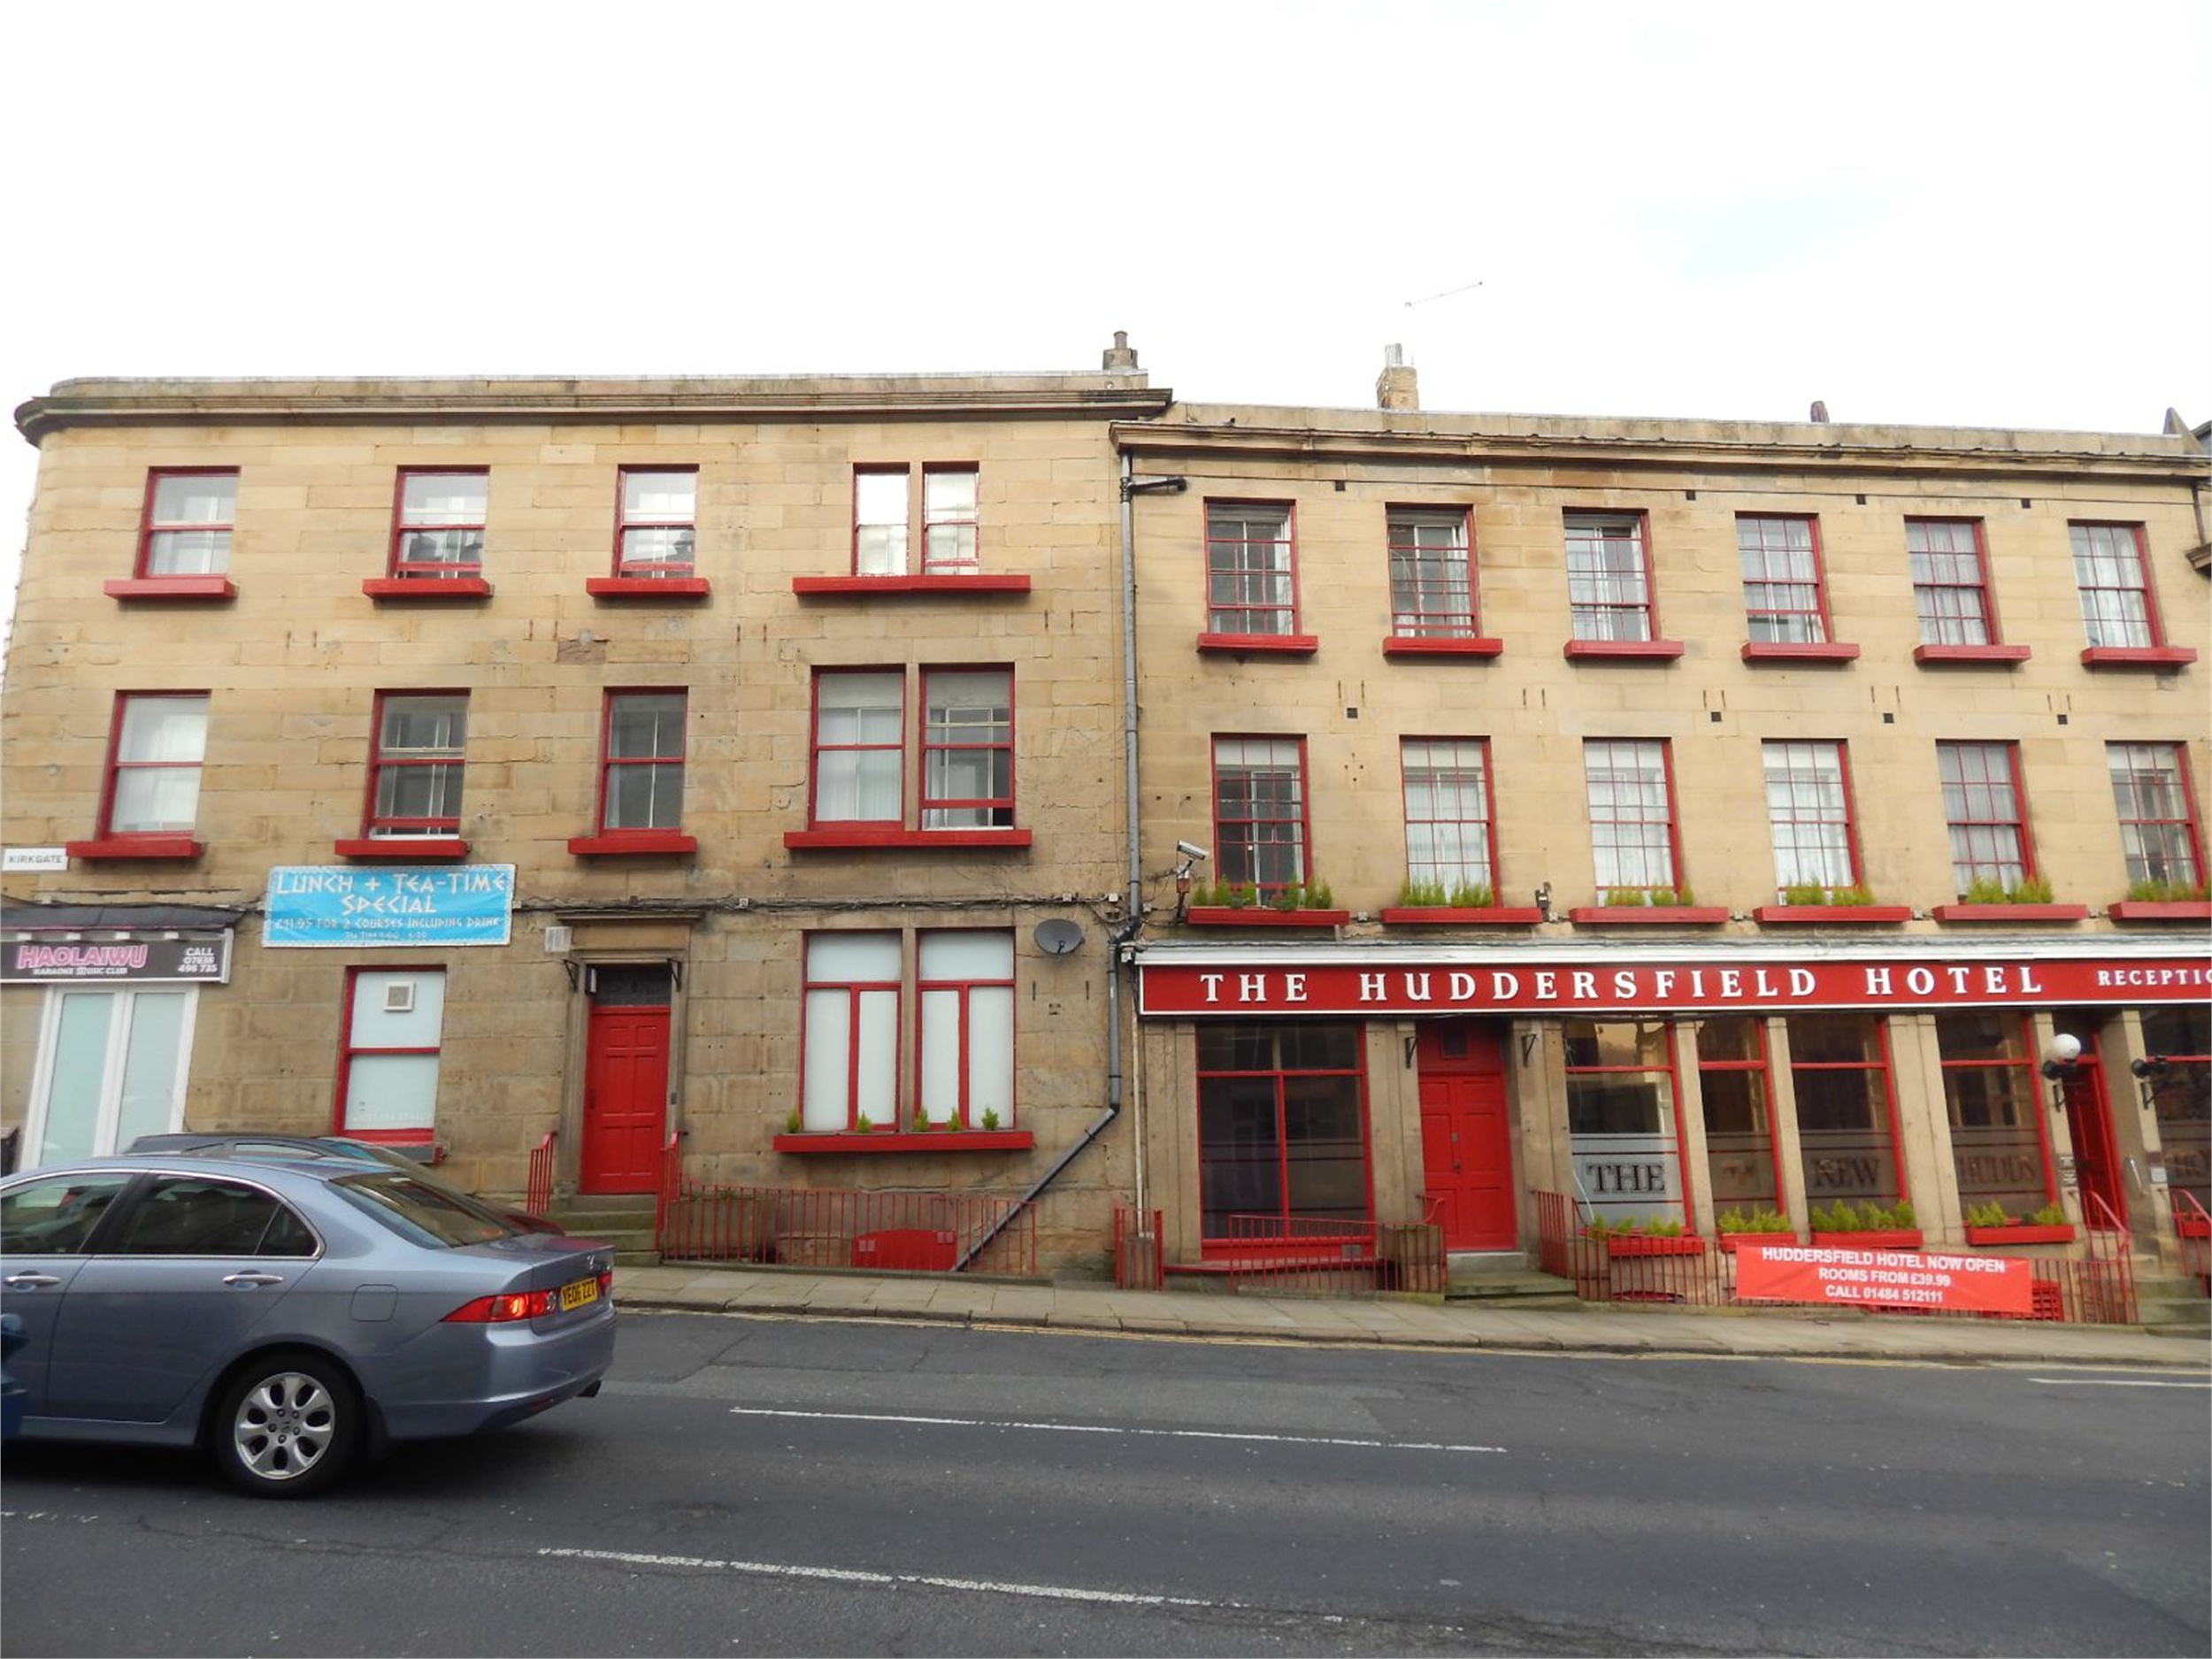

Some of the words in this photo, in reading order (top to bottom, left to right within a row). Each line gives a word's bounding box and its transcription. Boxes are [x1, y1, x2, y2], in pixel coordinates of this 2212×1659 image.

[8, 854, 63, 864] KIRKGATE
[276, 872, 353, 895] LUNCH
[392, 872, 506, 895] TEA-TIME
[342, 895, 437, 916] SPECIAL
[355, 917, 403, 930] COURSES
[408, 916, 463, 928] INCLUDING
[466, 916, 501, 928] DRINK
[16, 944, 149, 969] HAOLAIWU
[186, 947, 214, 956] CALL
[1200, 972, 1310, 1003] THE
[1358, 968, 1816, 1002] HUDDERSFIELD
[1864, 966, 2043, 995] HOTEL
[1586, 1162, 1667, 1194] THE
[1762, 1247, 1873, 1266] HUDDERSFIELD
[1877, 1251, 1924, 1269] HOTEL
[1927, 1255, 1962, 1271] NOW
[1965, 1257, 2006, 1273] OPEN
[1818, 1267, 1869, 1283] ROOMS
[1870, 1271, 1909, 1284] FROM
[1825, 1284, 1861, 1299] CALL
[1863, 1286, 1900, 1301] 01484
[1901, 1287, 1943, 1302] 512111
